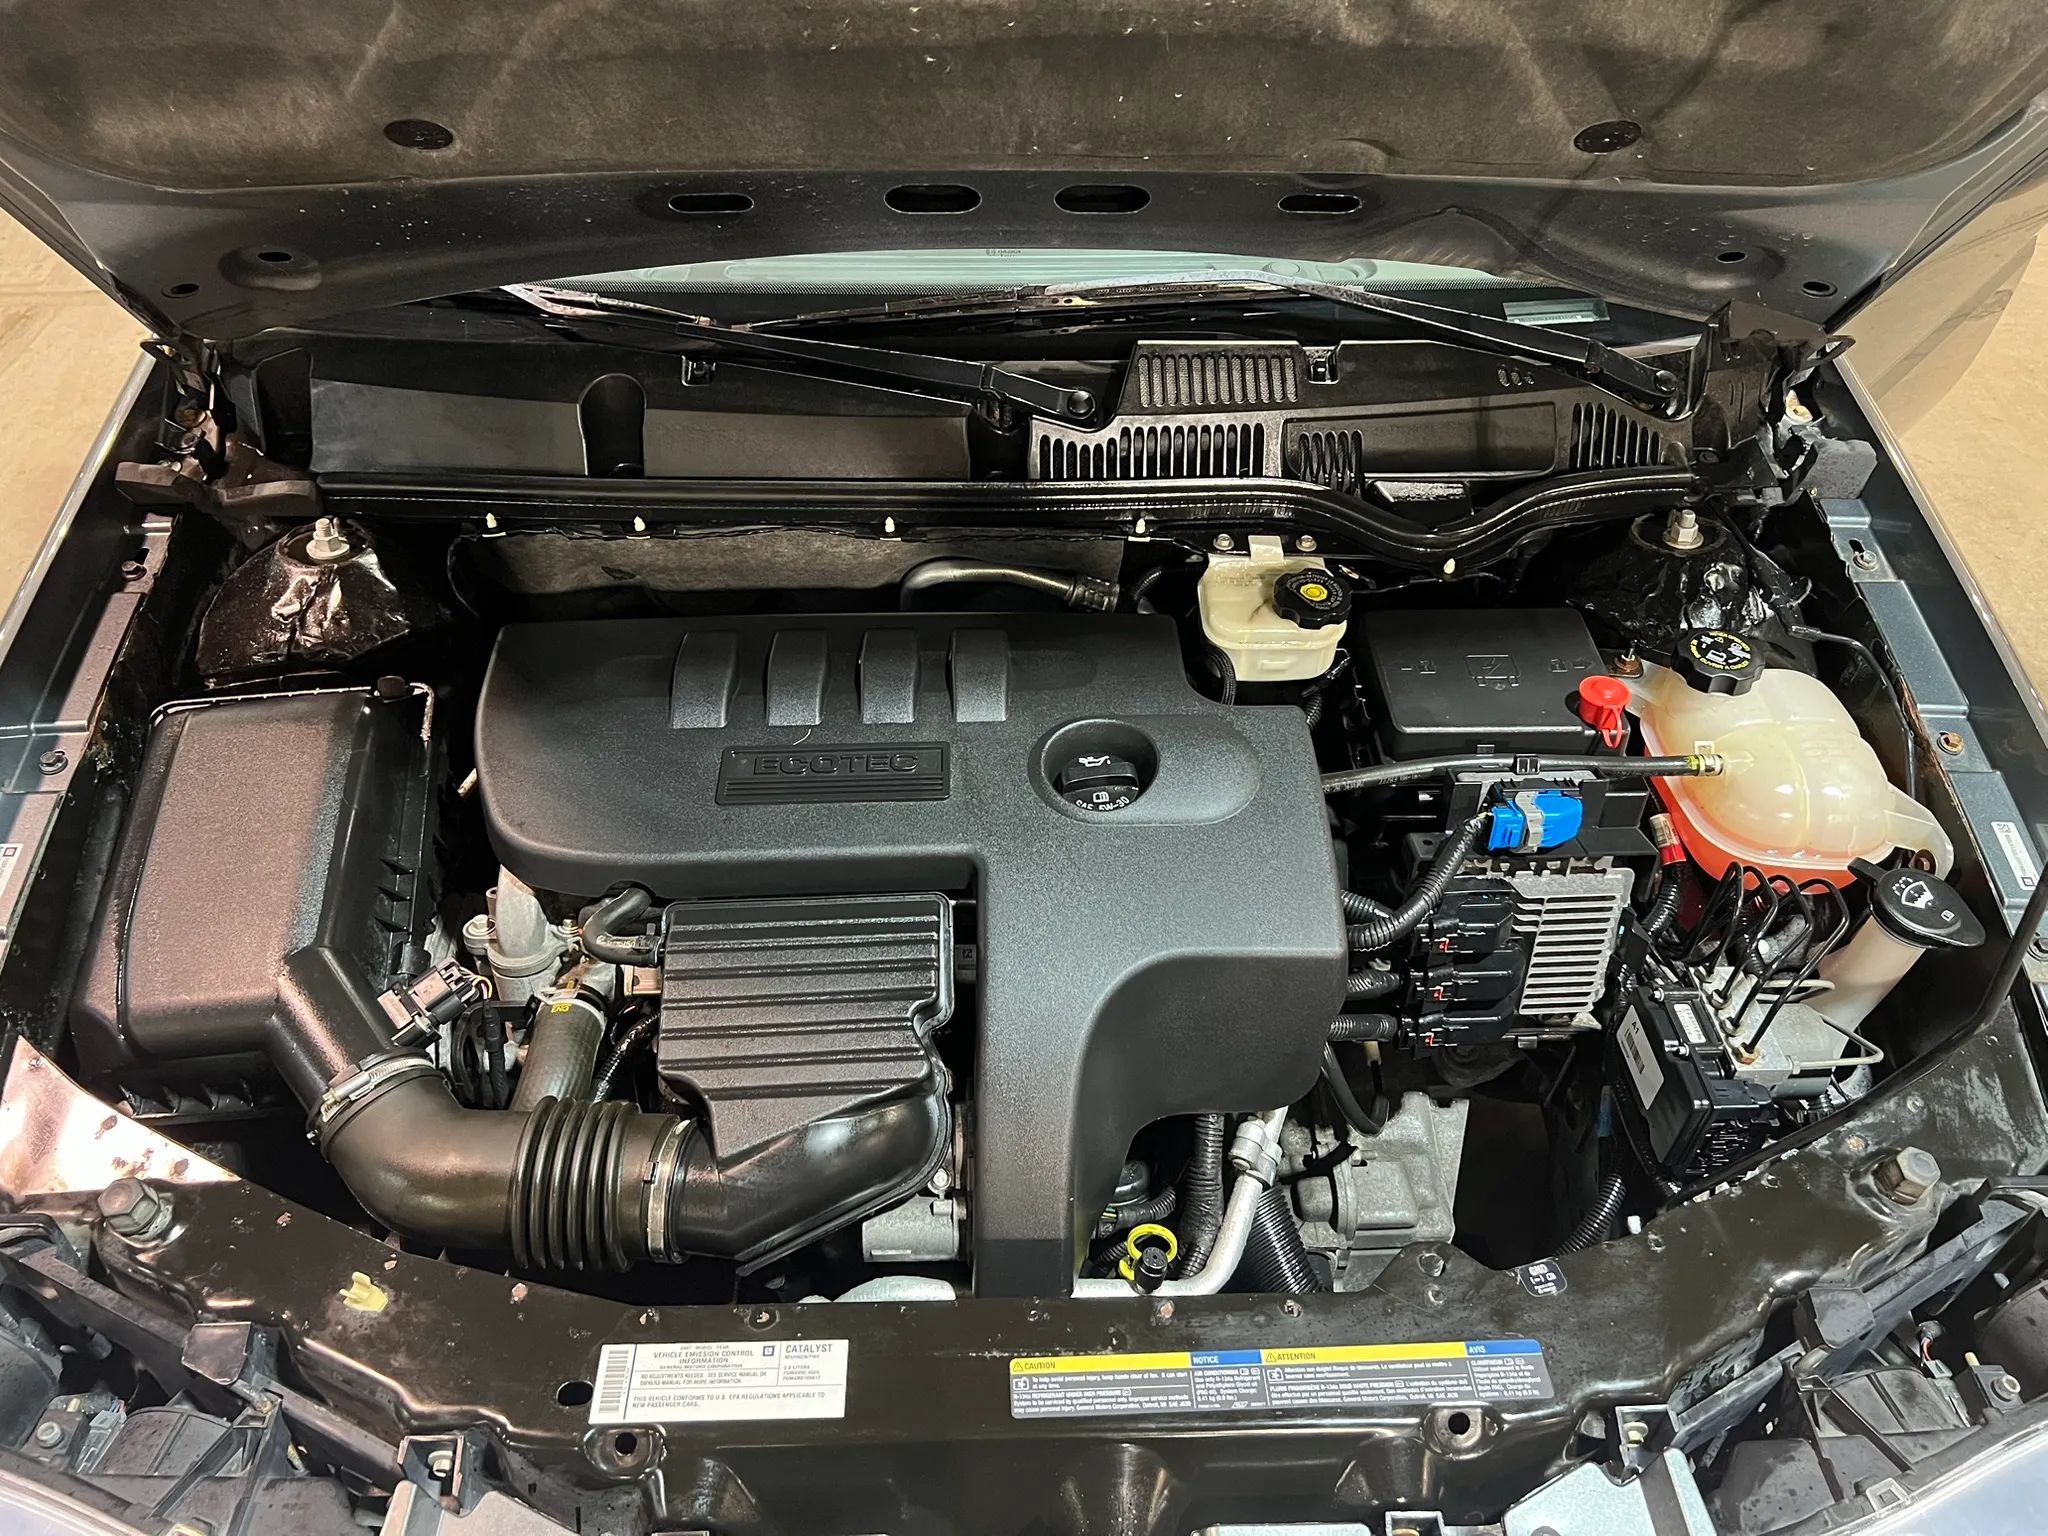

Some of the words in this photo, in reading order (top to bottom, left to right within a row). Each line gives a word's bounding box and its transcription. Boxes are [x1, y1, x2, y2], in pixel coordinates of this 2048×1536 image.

[753, 753, 920, 776] ECOTEC
[1075, 799, 1094, 810] SAE
[1098, 796, 1130, 811] 5W-30
[1528, 1263, 1548, 1276] GND
[785, 1344, 832, 1353] CATALYST
[1469, 1345, 1487, 1353] AVIS
[1192, 1356, 1220, 1364] NOTICE
[1024, 1362, 1056, 1370] CAUTION
